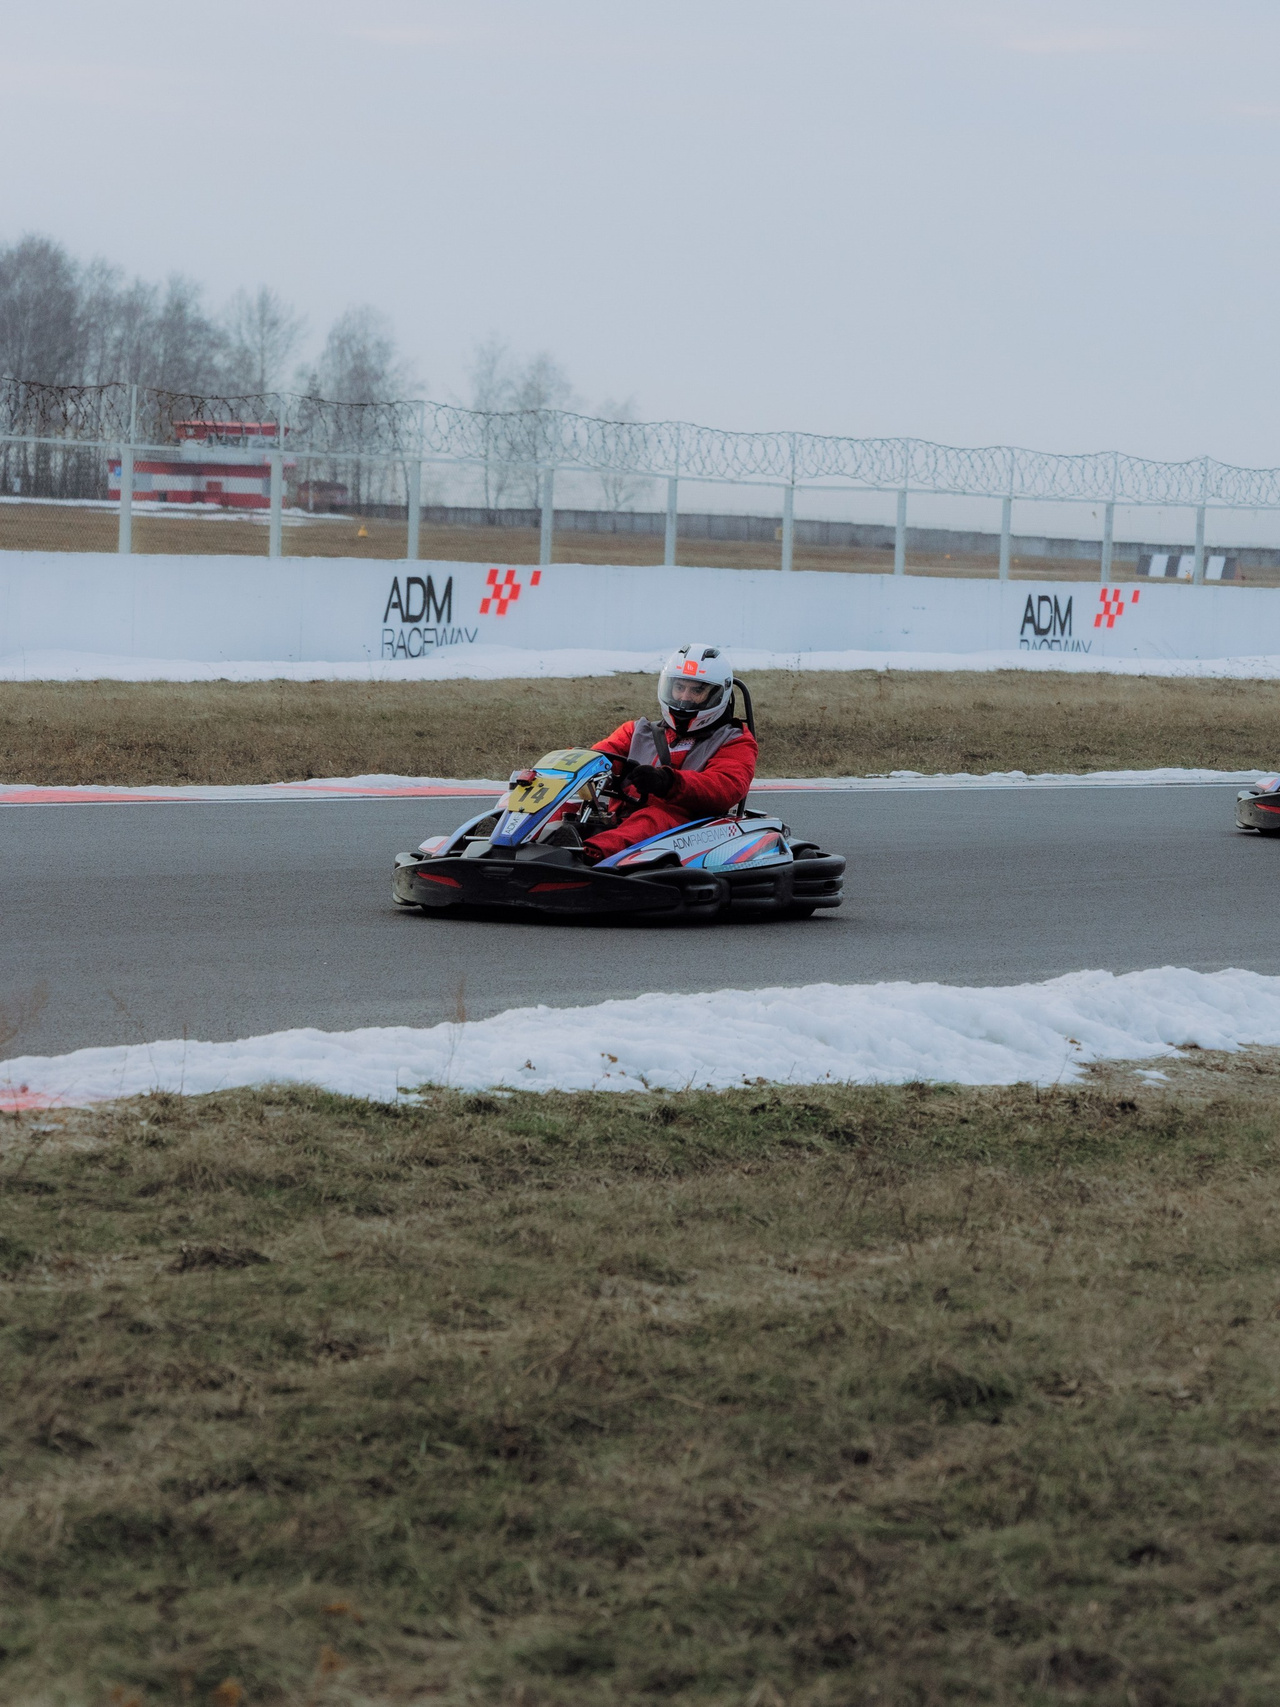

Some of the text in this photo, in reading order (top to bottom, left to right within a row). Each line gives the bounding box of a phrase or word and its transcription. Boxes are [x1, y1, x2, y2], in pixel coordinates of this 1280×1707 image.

[384, 575, 452, 623] ADM
[1020, 594, 1073, 636] ADM
[518, 786, 550, 803] 14
